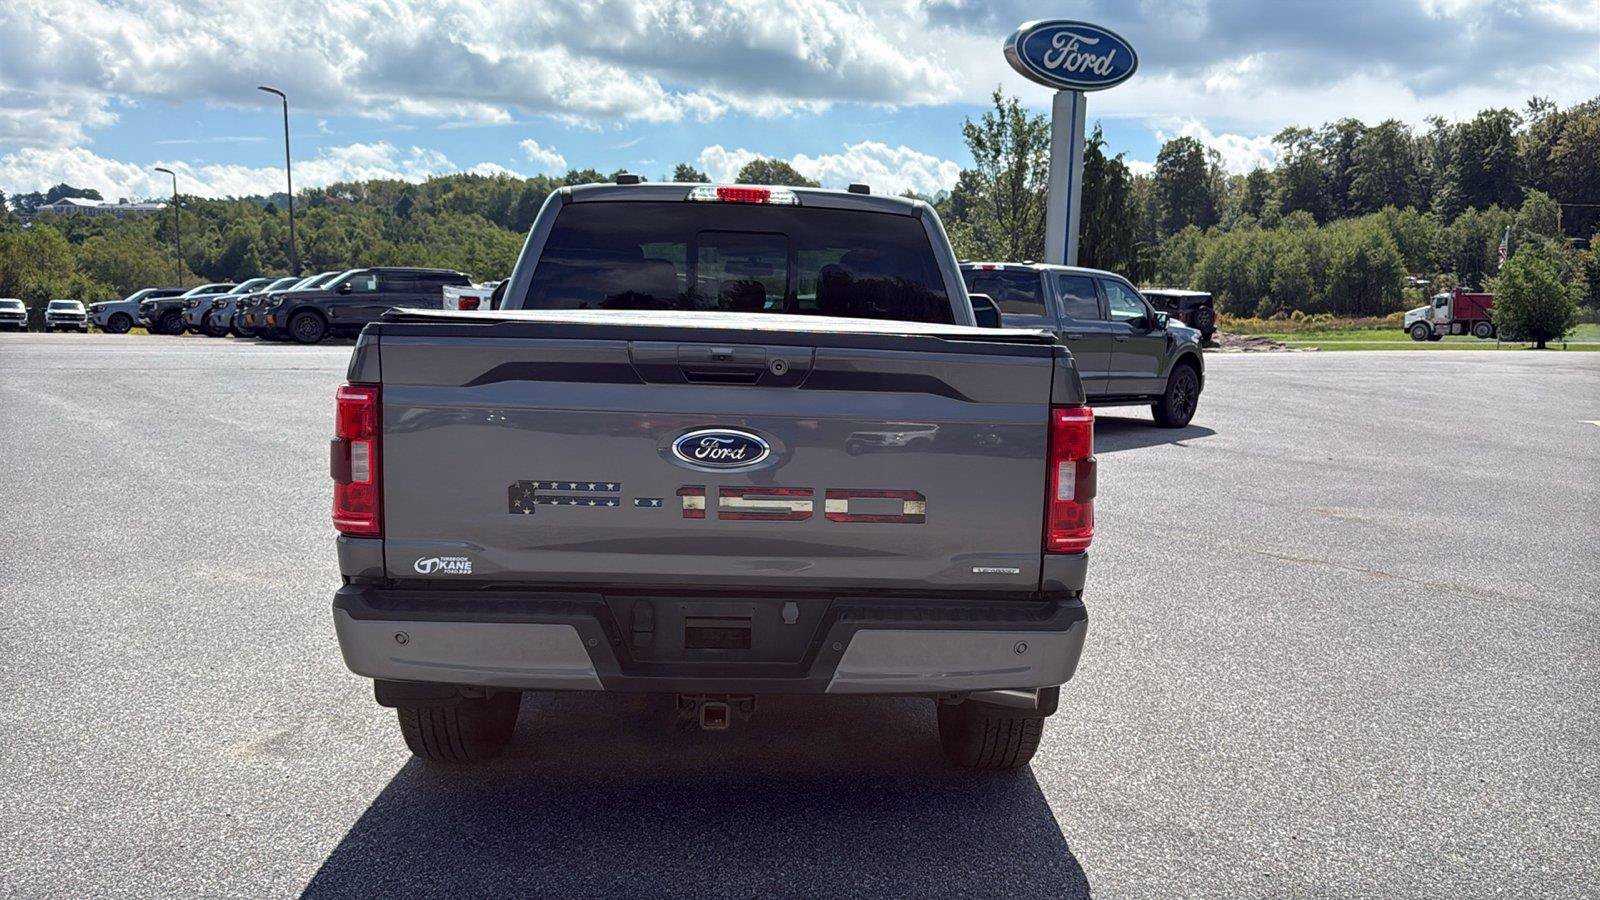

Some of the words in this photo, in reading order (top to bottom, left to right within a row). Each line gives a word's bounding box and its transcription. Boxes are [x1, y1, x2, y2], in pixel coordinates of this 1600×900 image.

[1043, 31, 1116, 76] Ford
[694, 437, 747, 460] Ford
[508, 479, 927, 524] F-150
[439, 561, 472, 570] KANE
